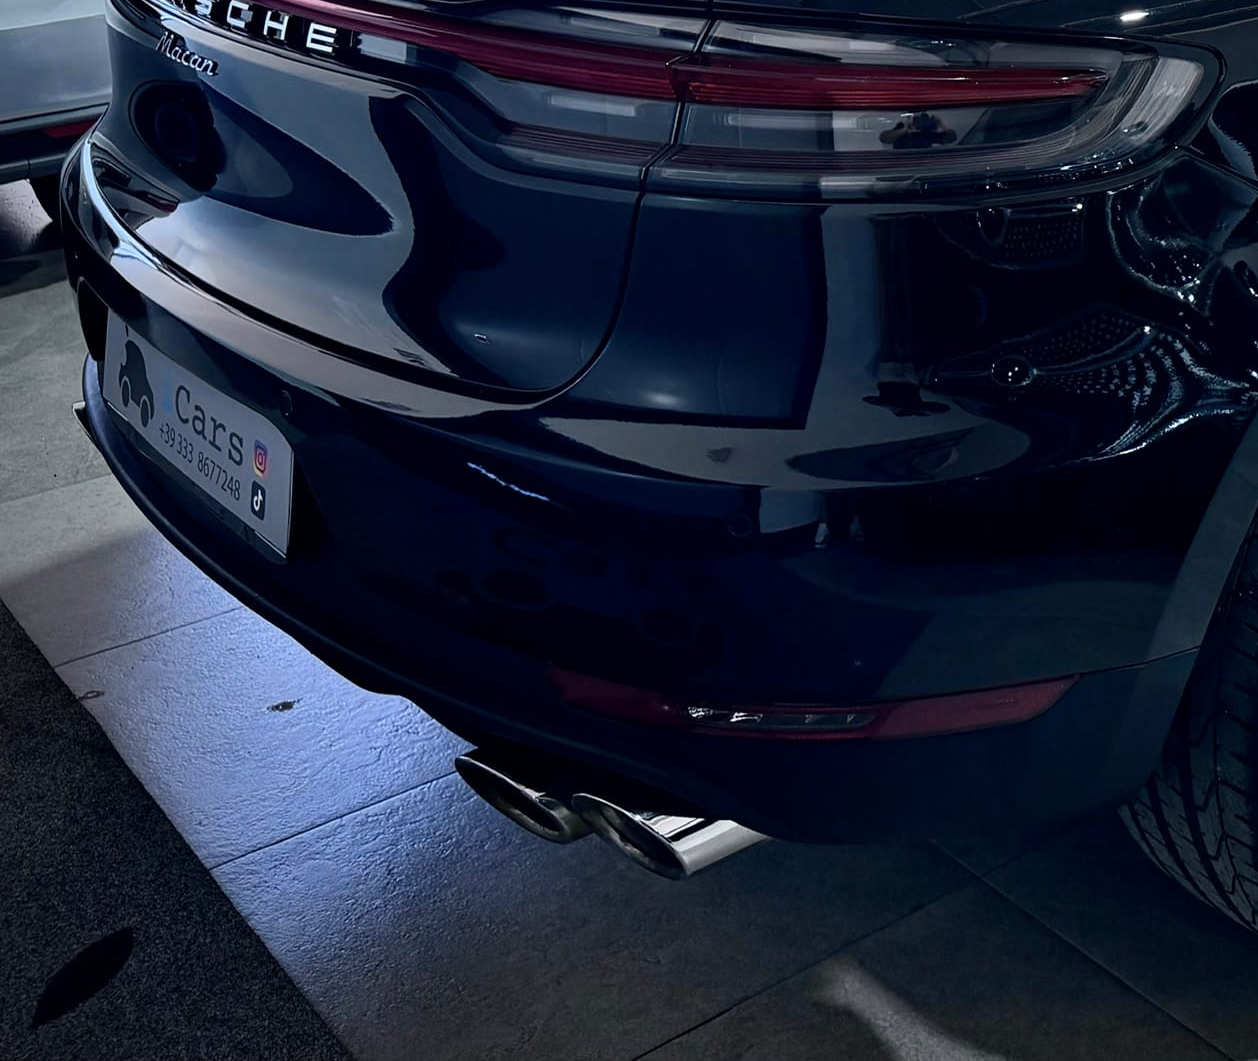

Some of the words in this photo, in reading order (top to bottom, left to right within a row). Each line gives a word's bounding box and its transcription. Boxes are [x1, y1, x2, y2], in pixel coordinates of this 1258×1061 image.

[155, 31, 219, 77] Macan
[175, 385, 244, 467] Cars
[197, 450, 242, 501] 8677248
